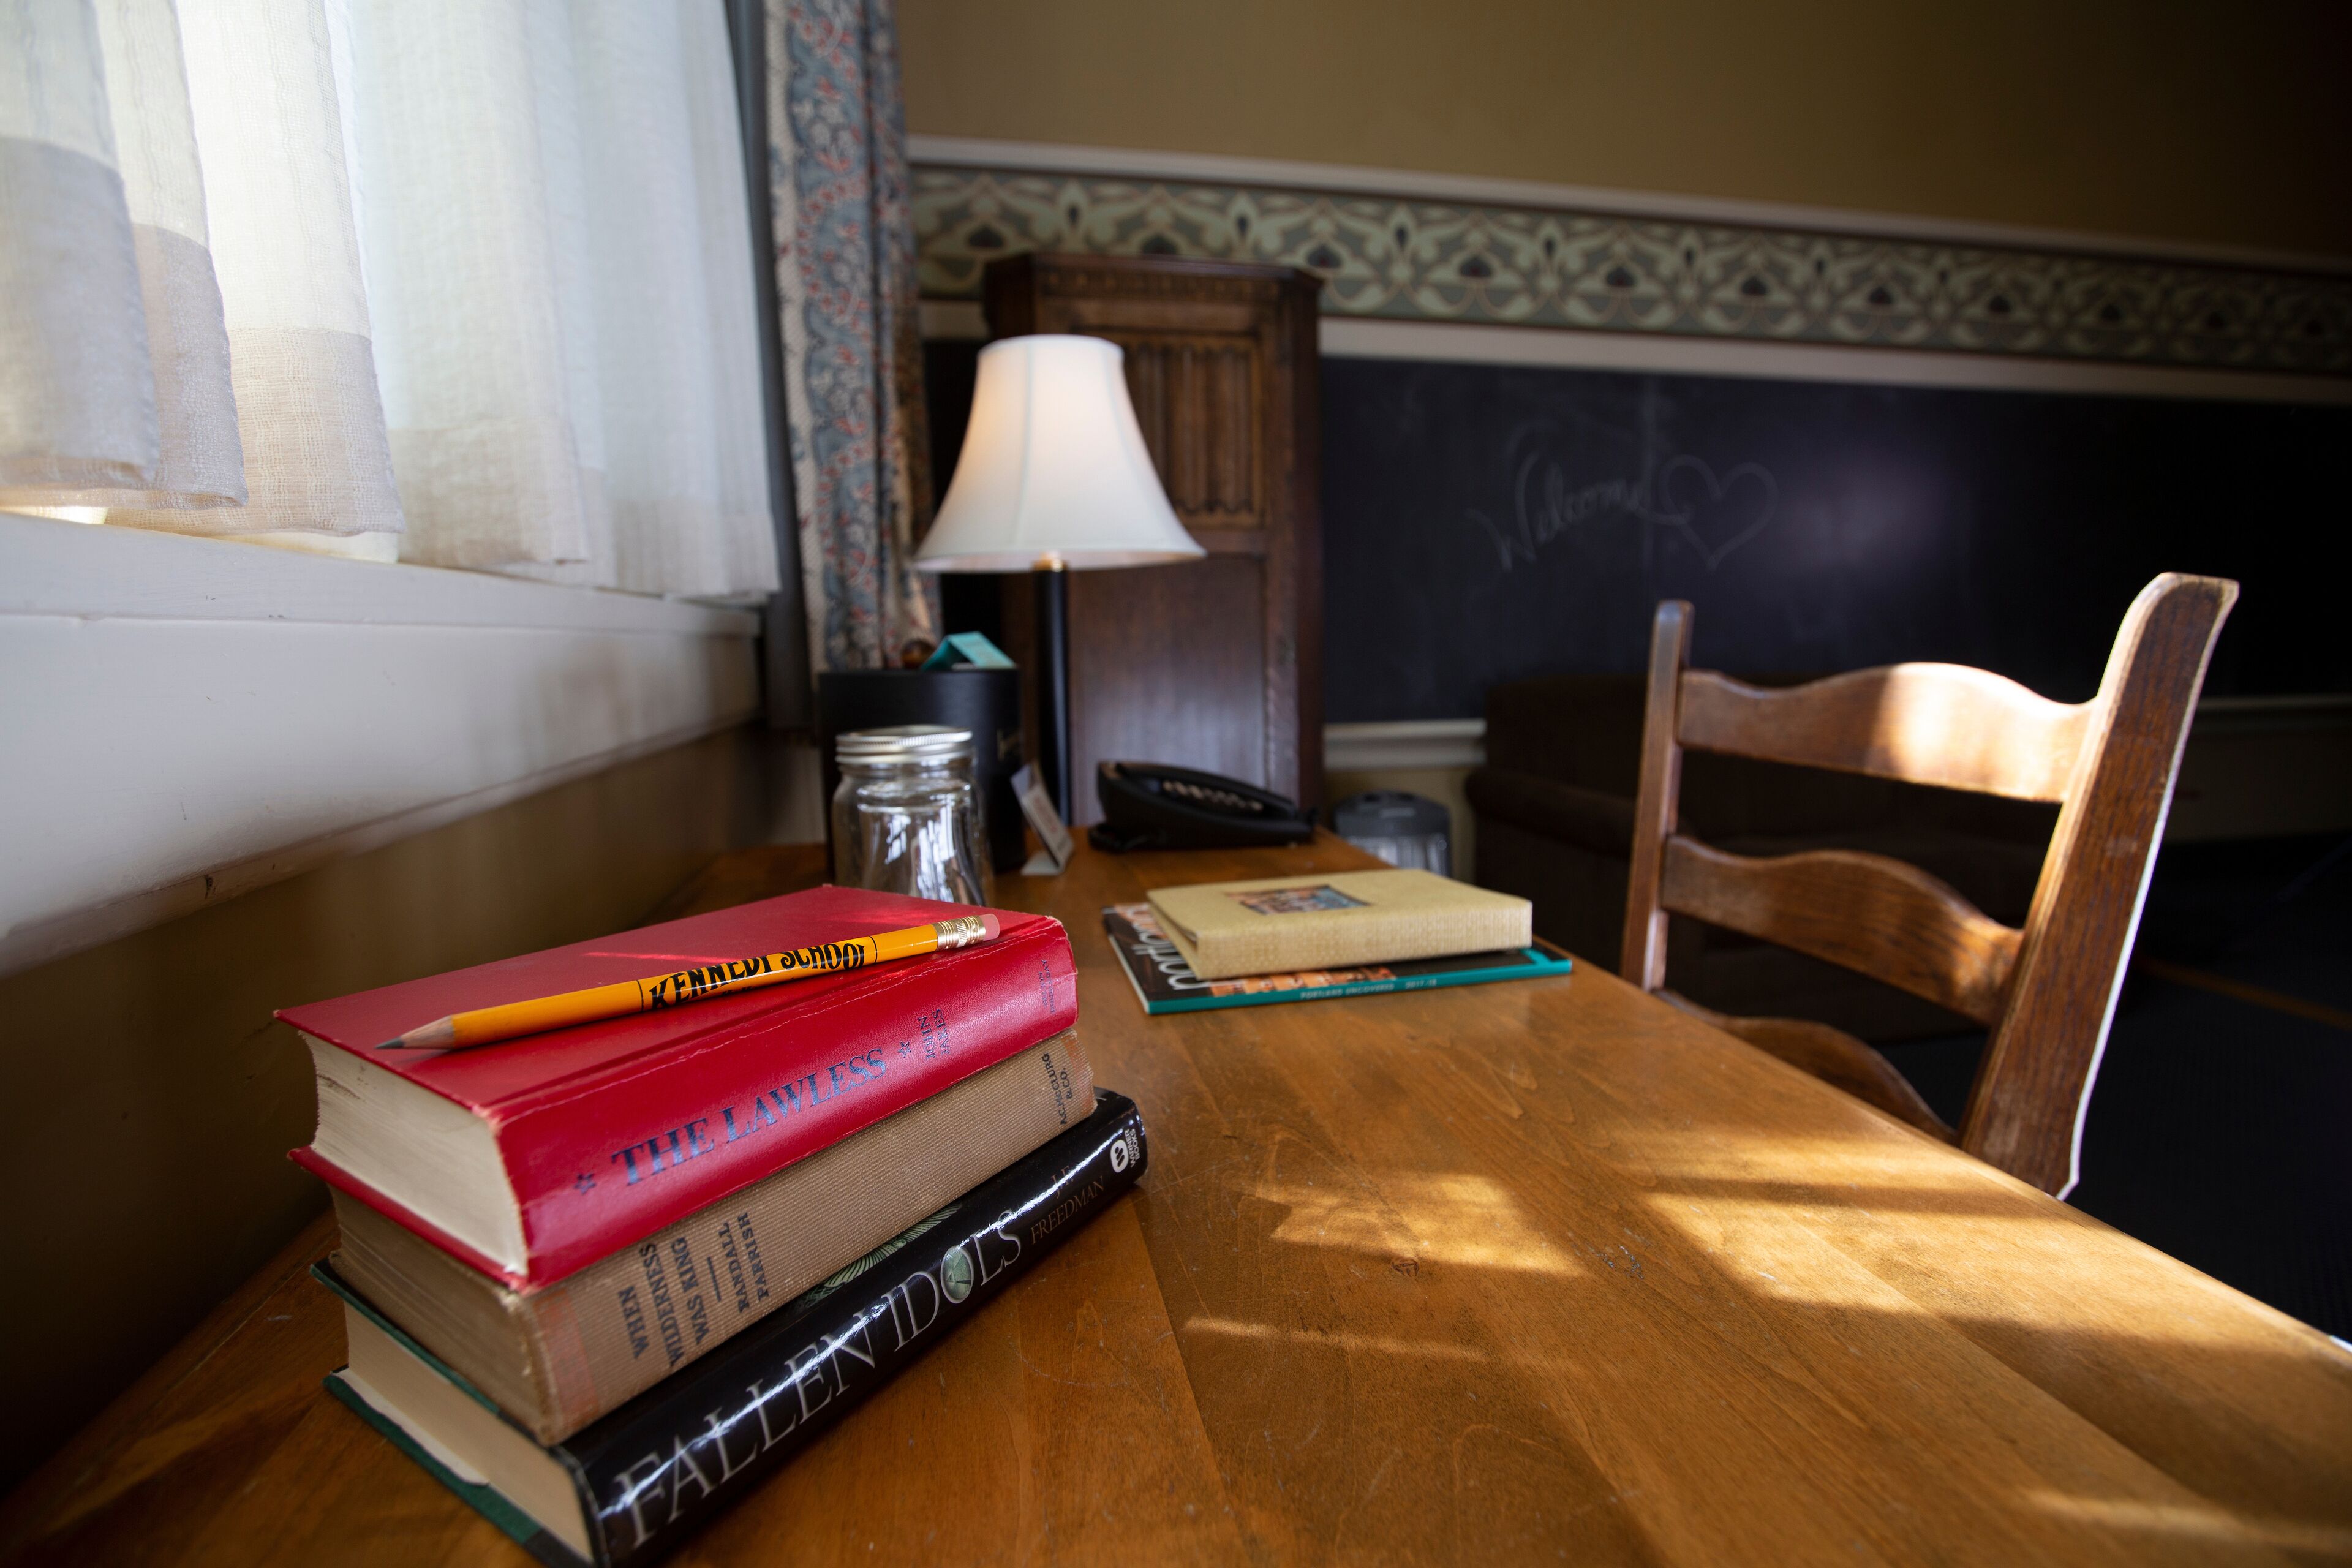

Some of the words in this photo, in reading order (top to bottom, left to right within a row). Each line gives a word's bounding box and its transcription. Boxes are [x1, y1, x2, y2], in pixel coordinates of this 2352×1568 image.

[1300, 988, 1343, 1000] PORTLAND
[918, 1016, 936, 1060] JOHN
[932, 1009, 950, 1055] JAKES
[611, 1117, 715, 1186] THE
[719, 1048, 886, 1144] LAWLESS
[1125, 1129, 1136, 1168] WARNER
[1130, 1128, 1140, 1161] BOOKS
[1031, 1175, 1104, 1245] FREEDMAN
[671, 1236, 699, 1293] KING
[718, 1222, 750, 1313] RANDALL
[737, 1212, 770, 1302] PARRISH
[617, 1286, 649, 1359] WHEN
[639, 1243, 685, 1367] WILDERNESS
[687, 1294, 710, 1346] WAS
[614, 1309, 876, 1550] FALLEN
[881, 1210, 1022, 1352] IDOLS
